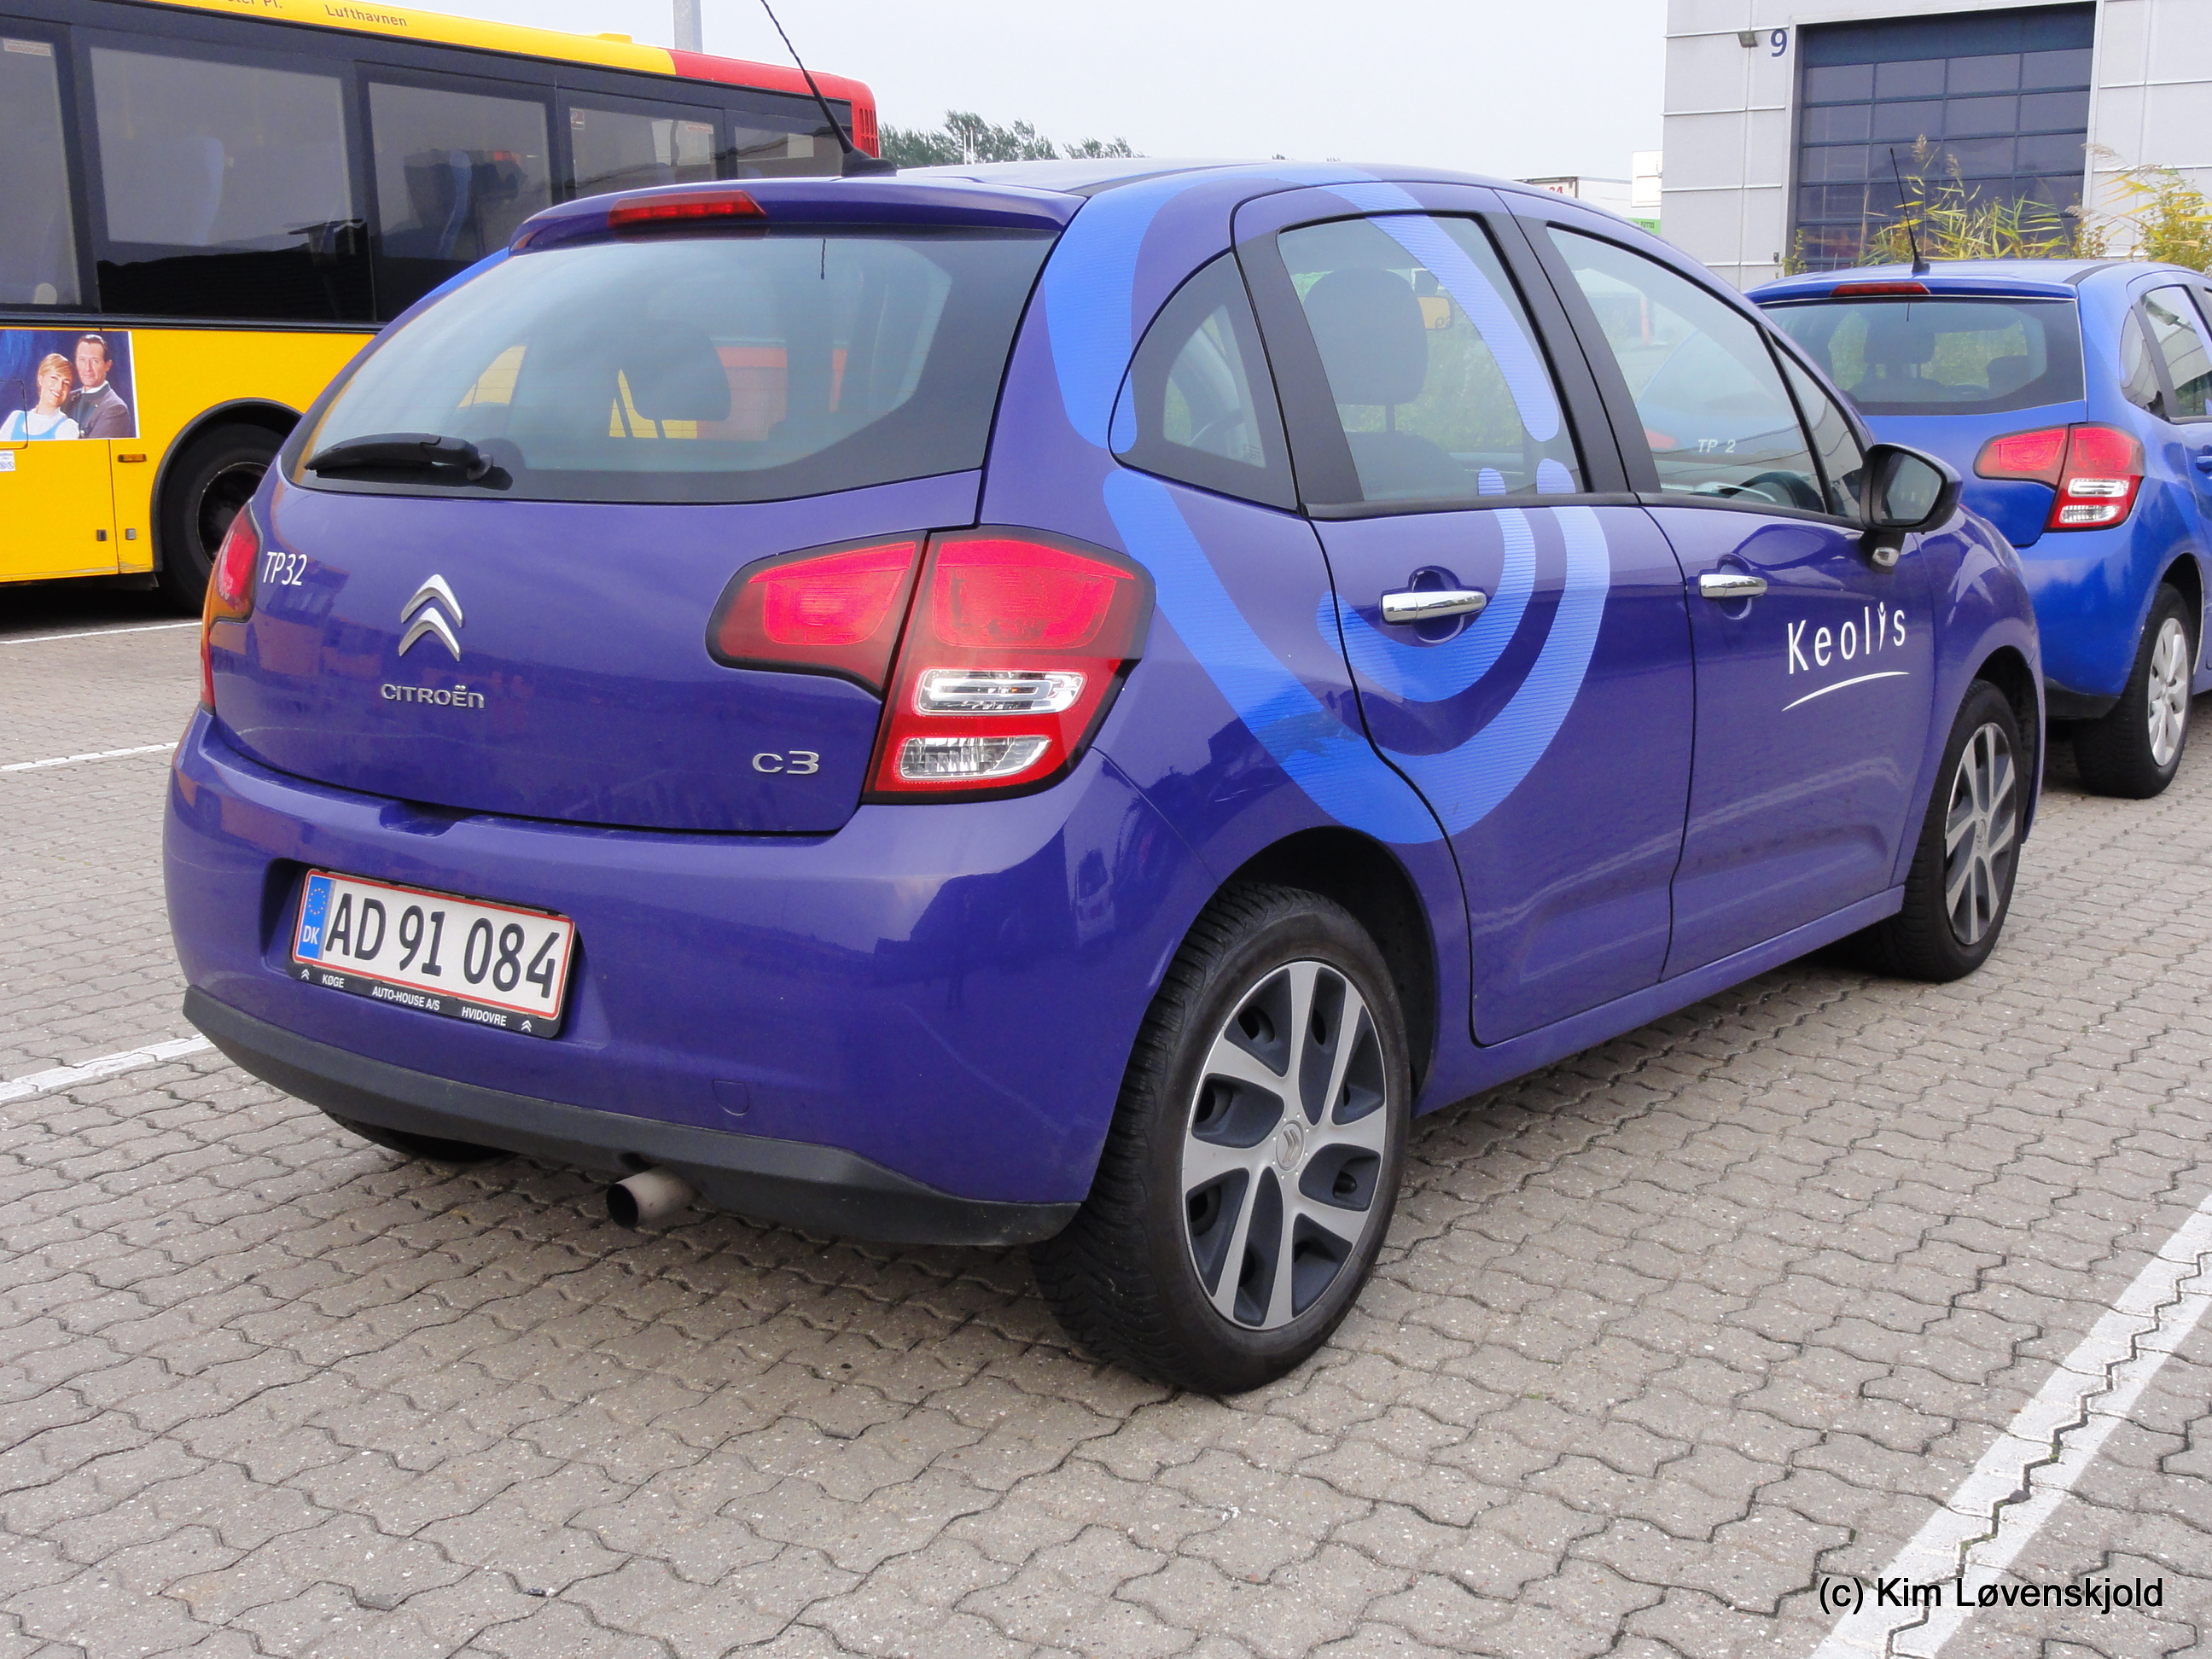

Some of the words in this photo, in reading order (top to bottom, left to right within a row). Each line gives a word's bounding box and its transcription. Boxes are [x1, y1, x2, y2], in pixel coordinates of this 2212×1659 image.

[325, 3, 408, 27] Lufthavnen
[1770, 29, 1787, 57] 9
[1697, 439, 1719, 453] TP
[1724, 439, 1737, 453] 2
[263, 551, 308, 586] TP32
[1787, 601, 1906, 675] Keolis
[381, 684, 486, 709] CITROËN
[752, 750, 819, 775] C3
[302, 925, 321, 946] DK
[325, 893, 387, 961] AD
[399, 905, 445, 977] 91
[463, 917, 560, 999] 084
[322, 974, 345, 988] KØGE
[372, 986, 425, 1008] AUTO-HOUSE
[426, 998, 440, 1011] A/S
[462, 1006, 507, 1027] HVIDOVRE
